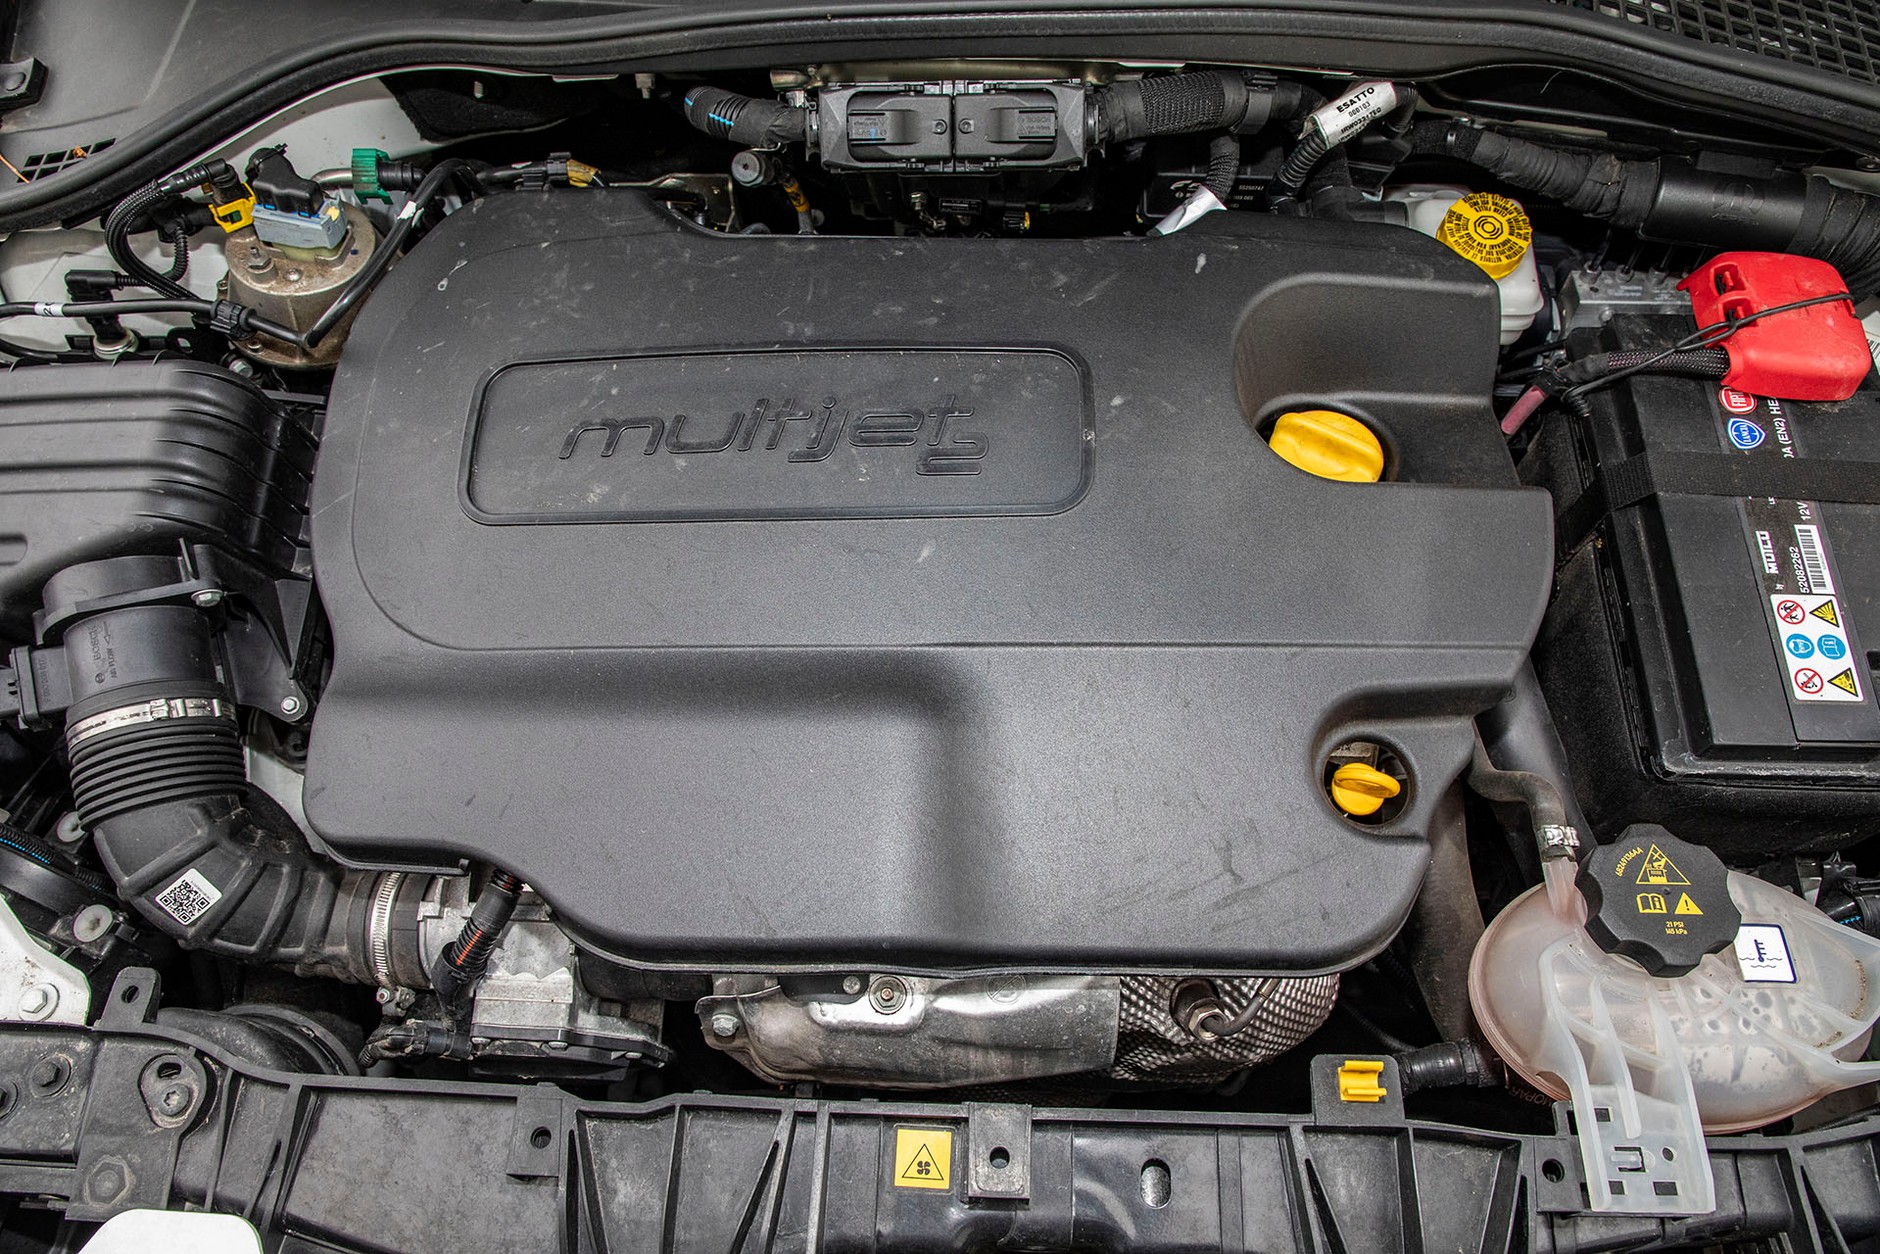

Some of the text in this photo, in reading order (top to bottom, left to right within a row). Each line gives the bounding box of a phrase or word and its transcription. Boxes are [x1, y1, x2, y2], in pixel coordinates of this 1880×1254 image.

[1336, 87, 1374, 112] ESATTO
[1348, 102, 1370, 117] 000103
[1728, 390, 1747, 406] FIAT
[1768, 396, 1782, 414] HE
[558, 394, 975, 462] multijet
[1773, 418, 1792, 444] (EN2)
[1796, 502, 1811, 520] 12V
[1789, 546, 1810, 593] 52082262
[106, 648, 115, 667] FLOW
